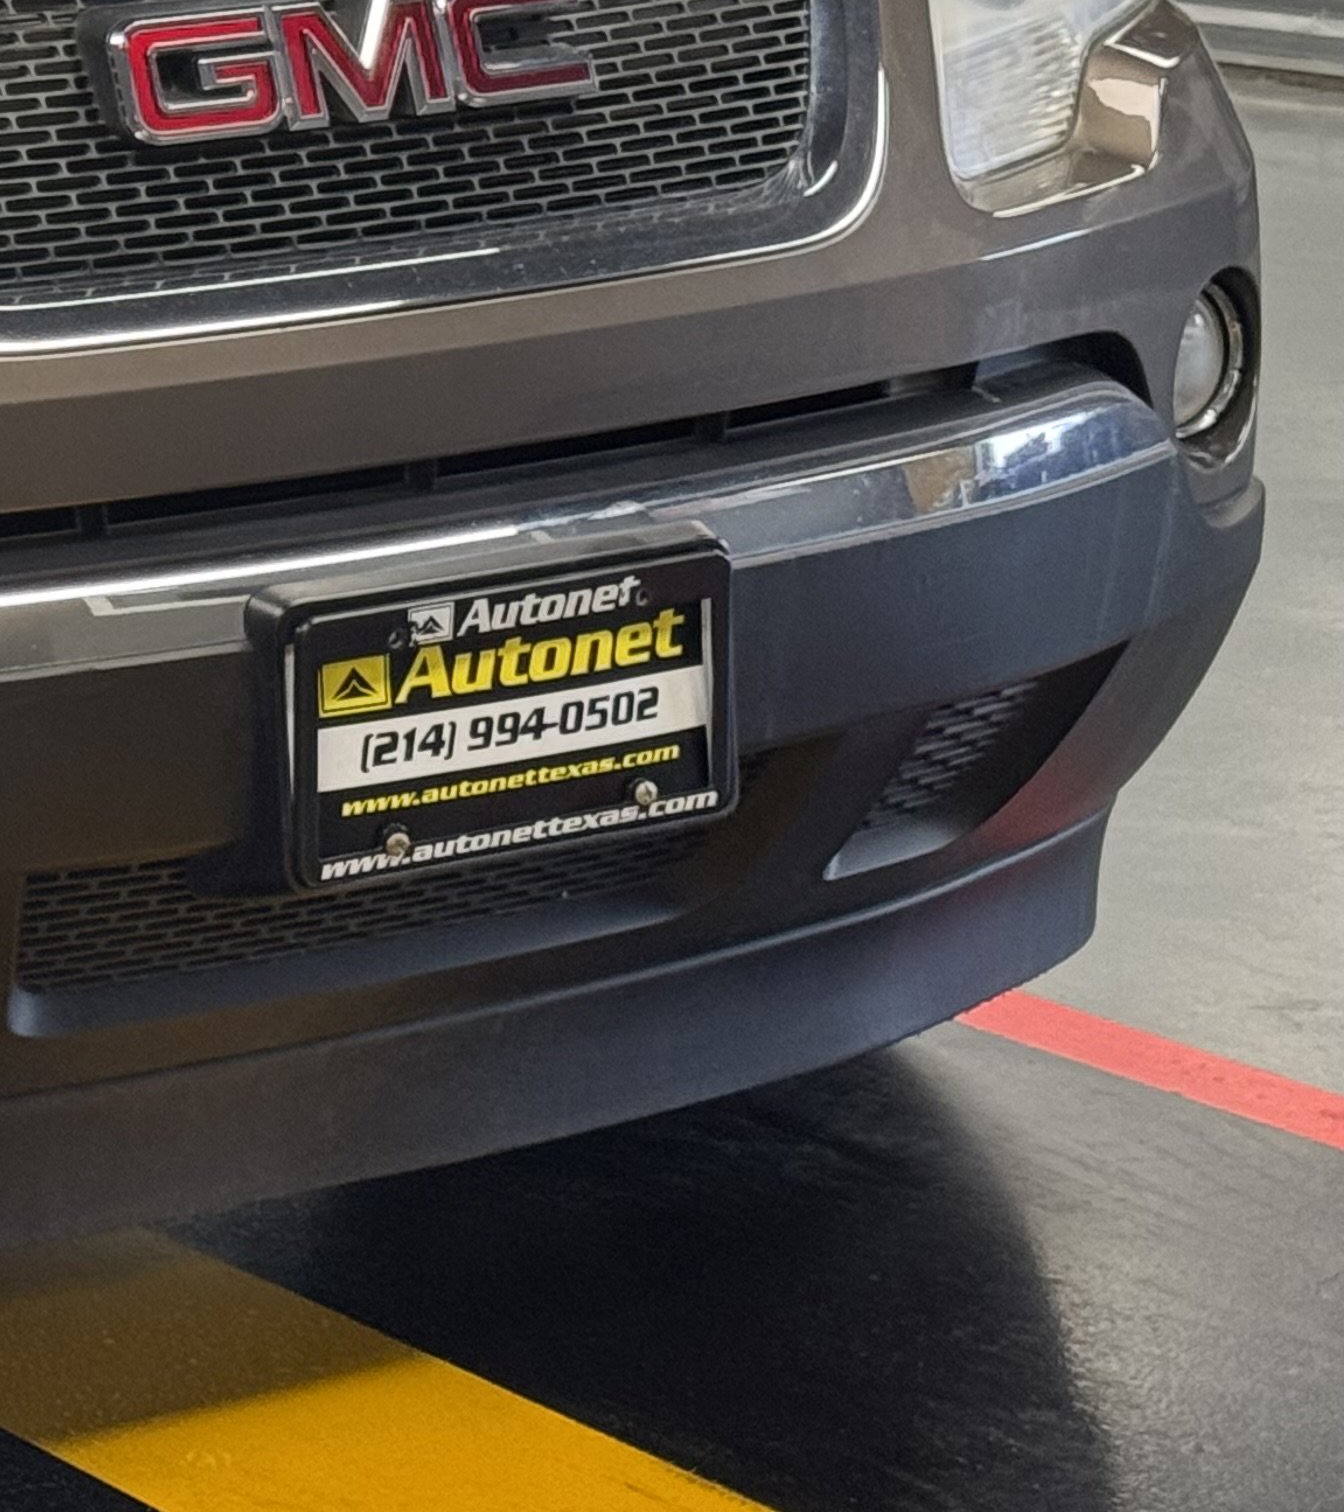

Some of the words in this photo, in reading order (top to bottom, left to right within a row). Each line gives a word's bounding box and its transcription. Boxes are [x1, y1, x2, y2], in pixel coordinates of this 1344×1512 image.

[456, 574, 641, 637] Autonet
[394, 607, 685, 705] Autonet
[360, 721, 457, 773] (214)
[467, 685, 659, 752] 994-0502
[340, 743, 680, 818] www.autonettexas.com
[319, 789, 719, 882] www.autonettexas.com
